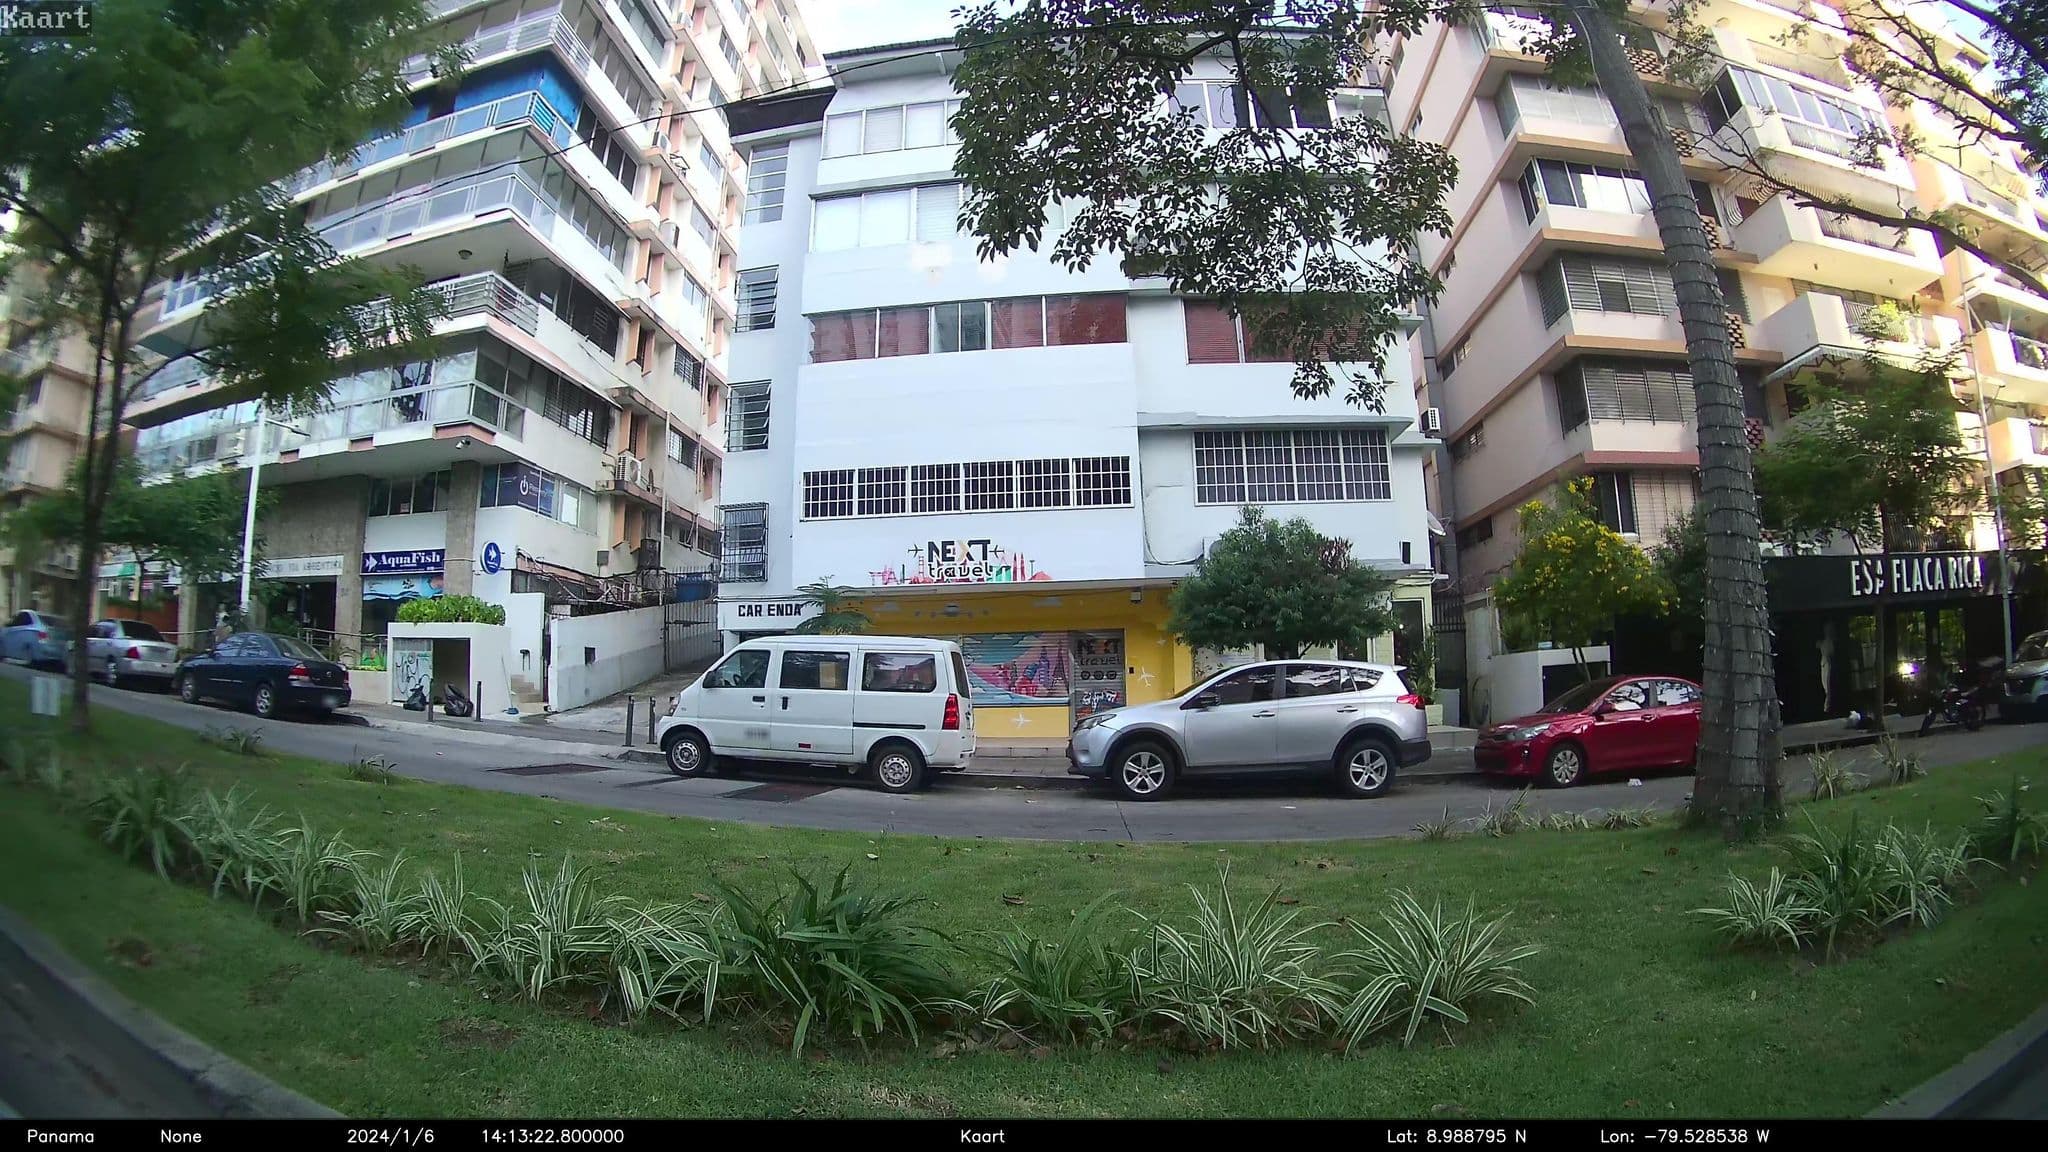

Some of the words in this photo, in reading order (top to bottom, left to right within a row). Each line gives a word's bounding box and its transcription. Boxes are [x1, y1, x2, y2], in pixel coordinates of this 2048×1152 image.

[379, 551, 441, 567] AquaFish
[927, 539, 991, 563] NEXT
[928, 562, 992, 579] travel
[1892, 556, 1945, 594] FLACA
[1948, 555, 1983, 589] RICA
[738, 604, 763, 617] CAR
